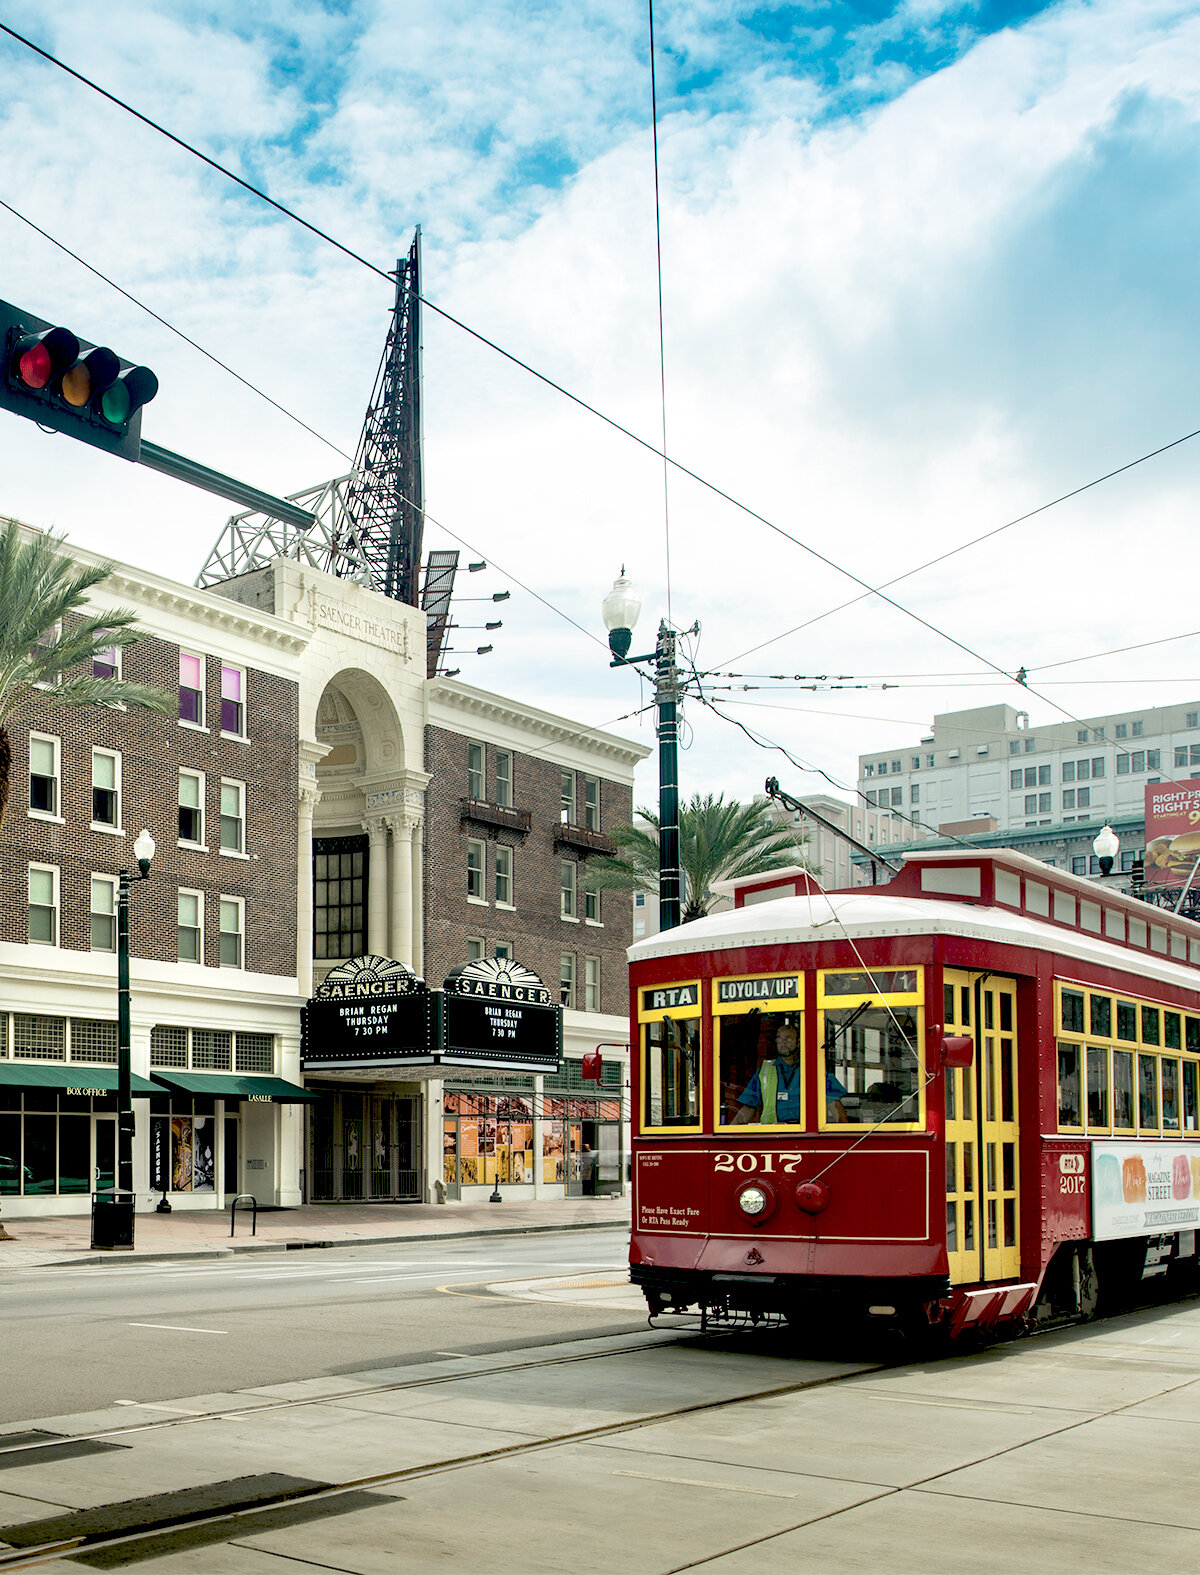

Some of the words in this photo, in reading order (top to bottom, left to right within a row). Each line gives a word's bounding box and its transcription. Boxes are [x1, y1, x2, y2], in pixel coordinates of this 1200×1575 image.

[319, 604, 362, 631] SAENGER
[363, 619, 403, 647] THEATRE
[1152, 791, 1187, 804] RIGHT
[1152, 800, 1192, 814] RIGHT
[1188, 810, 1200, 826] 9
[319, 980, 410, 998] SAENGER
[461, 980, 548, 1003] SAENGER
[653, 987, 693, 1008] RTA
[340, 1006, 364, 1017] BRIAN
[370, 1003, 398, 1015] REGAN
[484, 1006, 502, 1017] BRIAN
[505, 1008, 522, 1019] REGAN
[346, 1015, 389, 1027] THURSDAY
[490, 1017, 518, 1029] THURSDAY
[375, 1025, 388, 1035] PM
[507, 1029, 516, 1039] PM
[66, 1086, 82, 1096] BOX
[82, 1087, 108, 1097] OFFICE
[247, 1094, 273, 1103] LASALLE
[713, 1153, 803, 1174] 2017
[1063, 1158, 1075, 1170] RTA
[1147, 1171, 1171, 1184] MAGAZINE
[1059, 1175, 1086, 1194] 2017
[1147, 1185, 1172, 1201] STREET
[641, 1205, 656, 1214] Please
[656, 1206, 669, 1215] Have
[670, 1206, 686, 1216] Exact
[686, 1207, 700, 1216] Fare
[641, 1215, 648, 1224] Or
[648, 1216, 659, 1225] RTA
[659, 1216, 671, 1226] Pass
[671, 1217, 689, 1228] Ready
